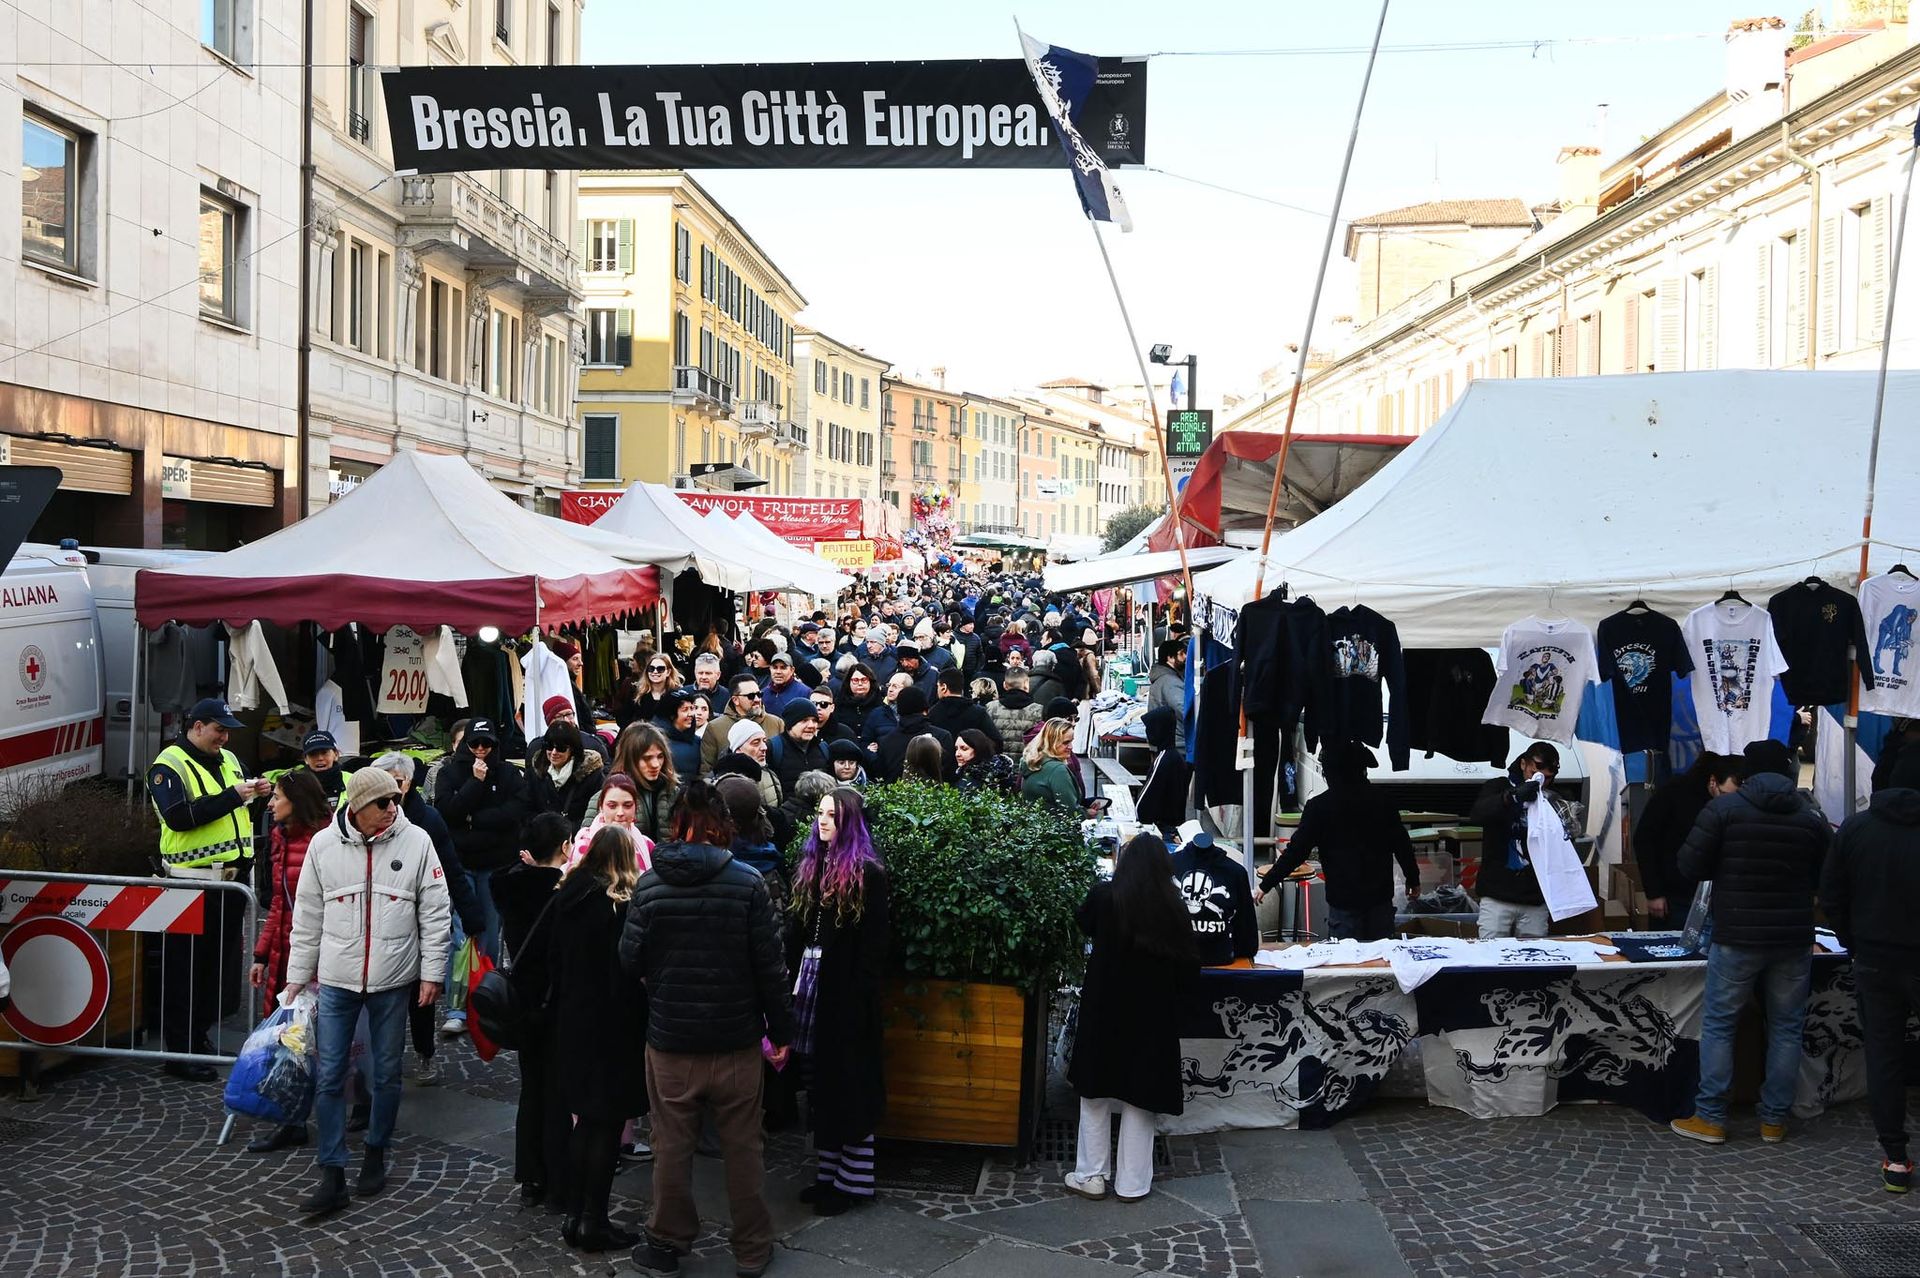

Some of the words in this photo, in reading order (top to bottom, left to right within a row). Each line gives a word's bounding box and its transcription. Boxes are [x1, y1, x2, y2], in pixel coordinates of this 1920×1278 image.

[411, 93, 587, 150] Brescia.
[598, 92, 650, 146] La
[655, 92, 733, 145] Tua
[741, 90, 848, 146] Città
[863, 91, 1048, 159] Europea.
[1180, 412, 1198, 422] AREA
[1171, 422, 1206, 432] PEDONALE
[1182, 432, 1196, 442] NON
[1176, 442, 1200, 452] ATTIVA
[762, 501, 849, 515] FRITTELLE
[822, 543, 871, 553] FRITTELLE
[0, 585, 58, 608] ALIANA
[1613, 642, 1656, 658] Brescia
[70, 896, 109, 907] Brescia
